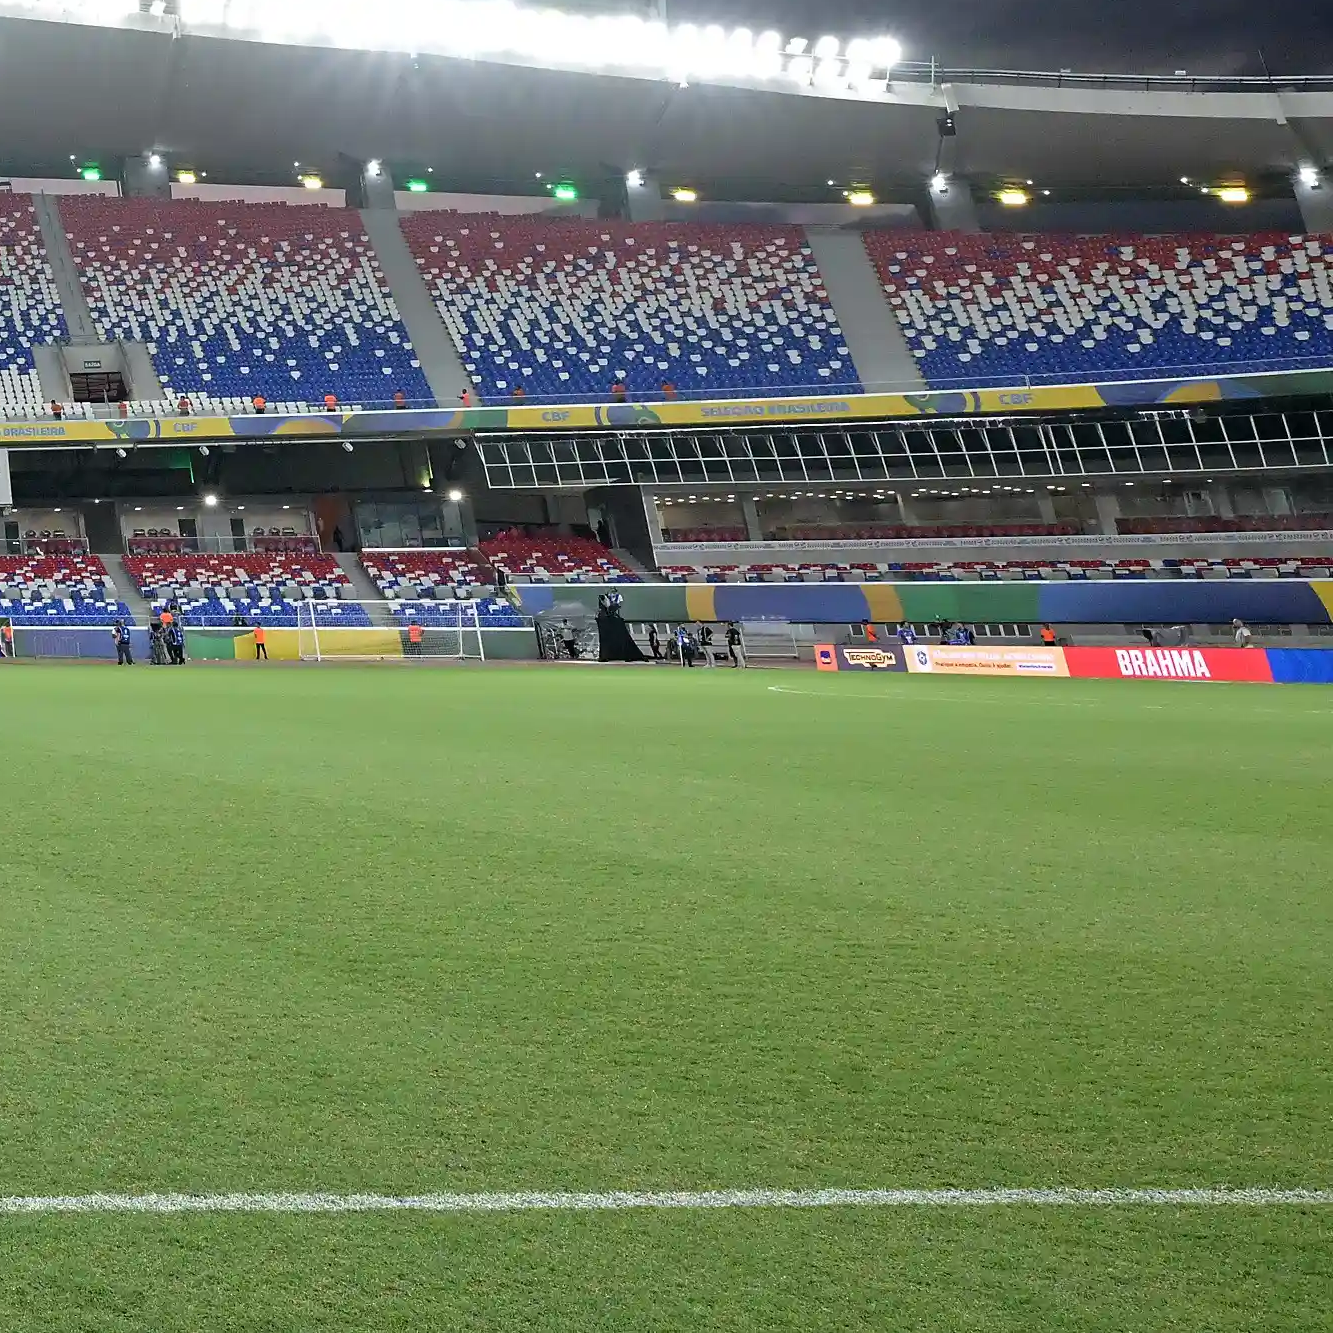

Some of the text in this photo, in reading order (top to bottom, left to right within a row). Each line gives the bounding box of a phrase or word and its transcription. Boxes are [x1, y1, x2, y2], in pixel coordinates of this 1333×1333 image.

[999, 393, 1033, 405] CBF
[541, 410, 571, 422] CBF
[4, 426, 66, 437] BRASILEIRA
[173, 422, 199, 433] CBF
[1115, 649, 1211, 677] BRAHMA
